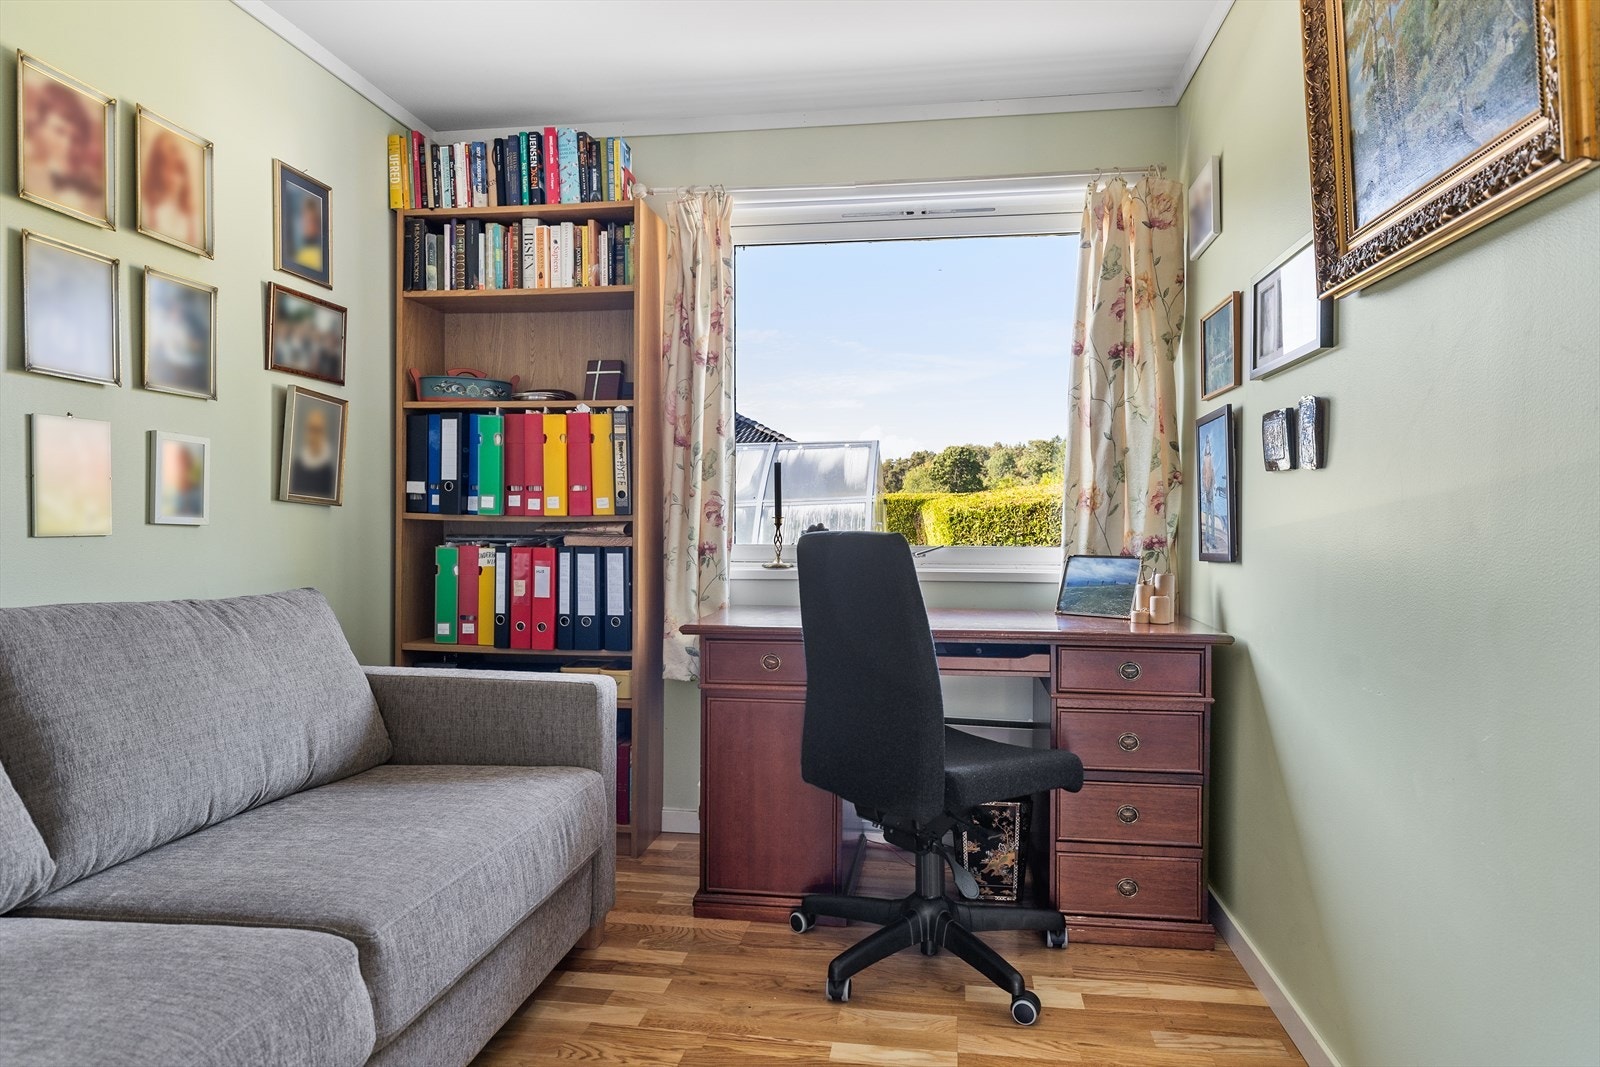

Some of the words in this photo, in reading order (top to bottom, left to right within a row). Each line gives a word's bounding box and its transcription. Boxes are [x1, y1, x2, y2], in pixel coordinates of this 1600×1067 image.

[529, 137, 537, 167] JENSEN
[389, 154, 400, 184] UFRED
[524, 232, 534, 271] IBSEN
[552, 245, 560, 273] Sapiens
